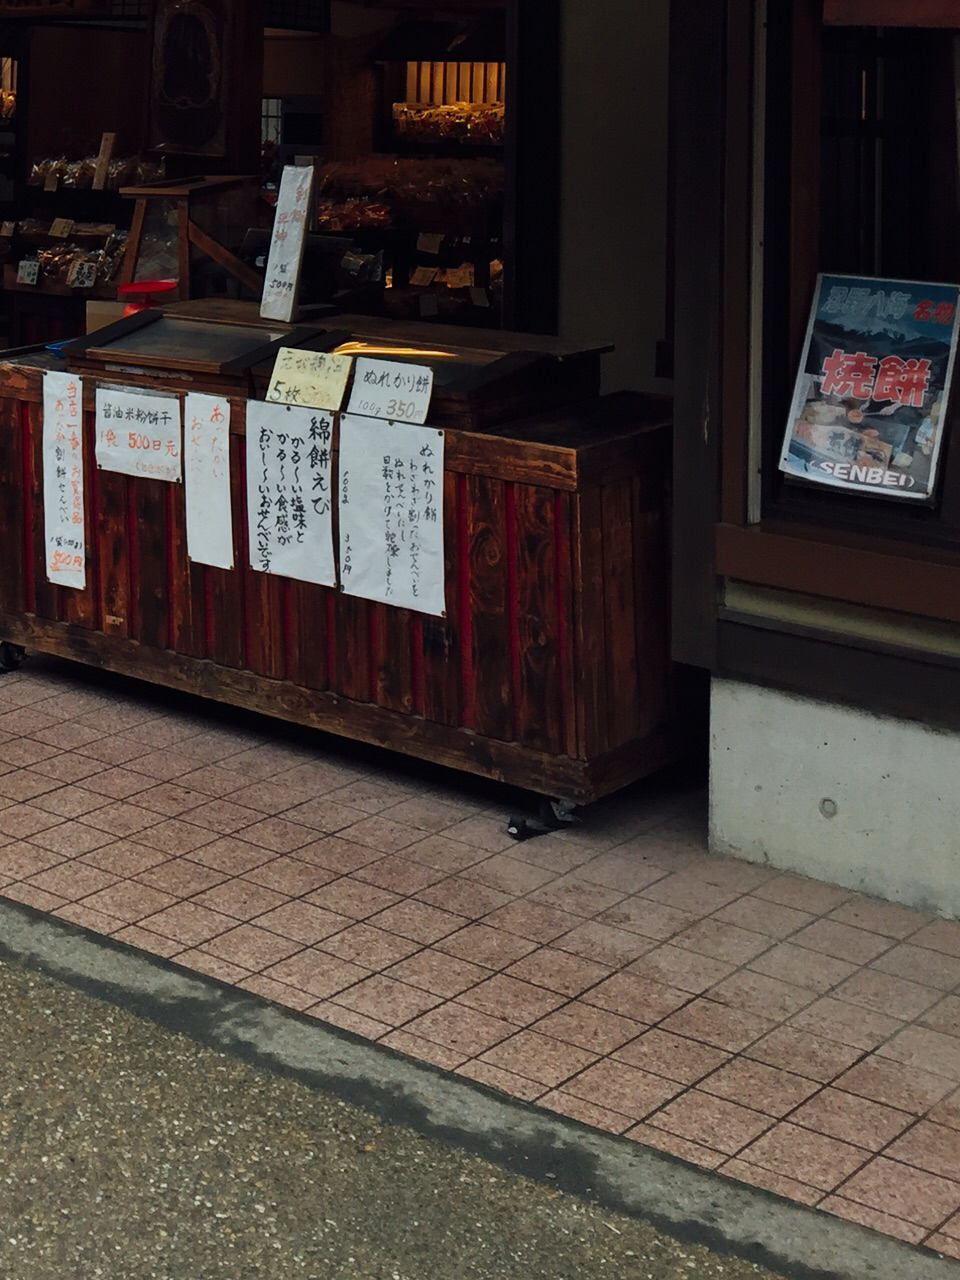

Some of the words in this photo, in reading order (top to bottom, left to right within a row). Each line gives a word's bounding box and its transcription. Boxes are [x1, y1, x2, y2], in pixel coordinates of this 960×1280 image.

[821, 286, 912, 320] 忍野八海
[912, 299, 956, 323] 名物
[363, 369, 430, 394] ぬれかり餅
[128, 431, 178, 457] 500日元
[210, 404, 226, 478] あったかい
[306, 416, 331, 515] 綿餅えび
